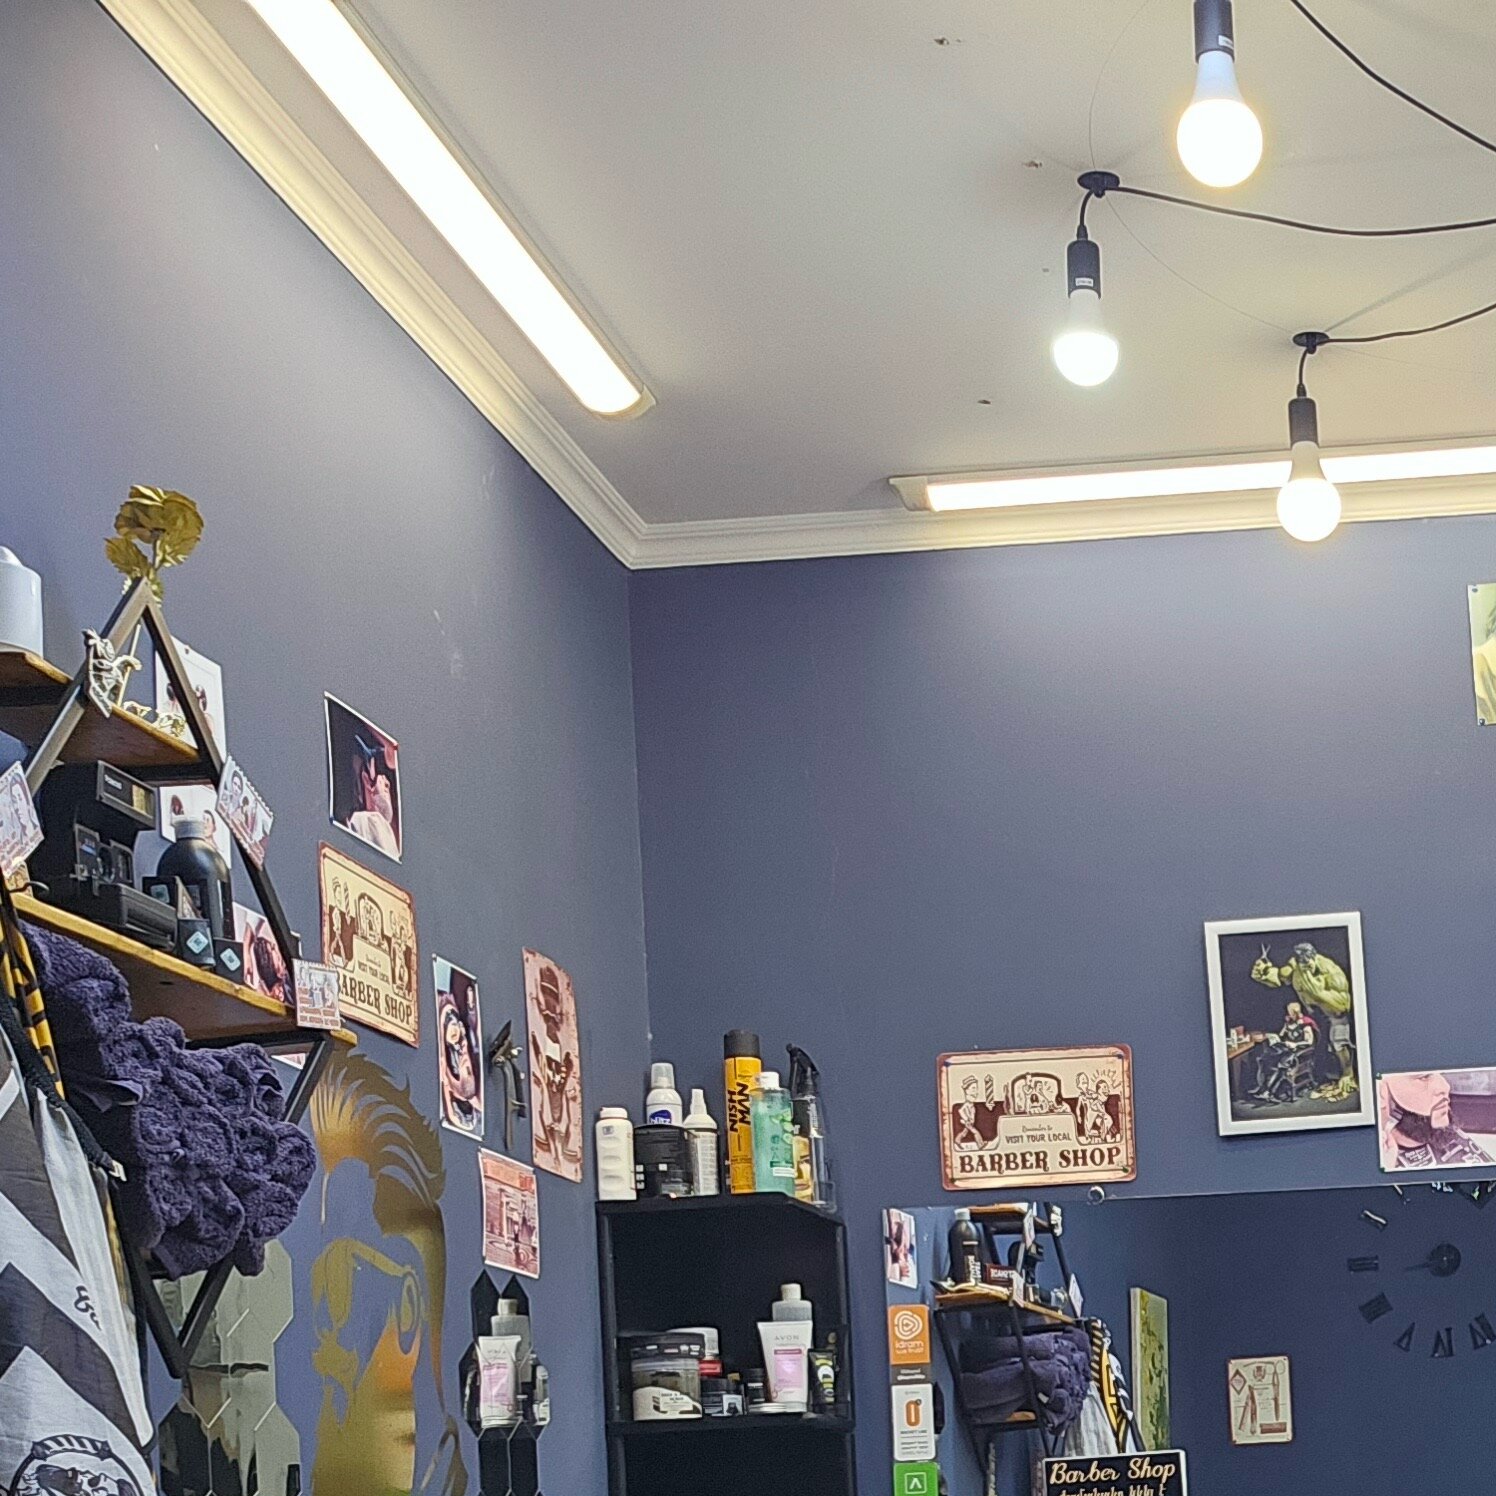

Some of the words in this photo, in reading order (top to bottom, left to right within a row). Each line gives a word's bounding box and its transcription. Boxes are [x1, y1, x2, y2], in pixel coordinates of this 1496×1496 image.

[337, 971, 382, 1014] ARBER
[385, 994, 413, 1025] SHOP
[728, 1088, 739, 1133] NISH
[736, 1081, 752, 1126] MAN
[1005, 1135, 1024, 1144] VISIT
[1026, 1134, 1046, 1143] YOUR
[959, 1150, 1050, 1175] BARBER
[1058, 1146, 1121, 1168] SHOP
[774, 1334, 800, 1342] AVON
[1050, 1461, 1120, 1484] Barber
[1128, 1457, 1176, 1484] Shop
